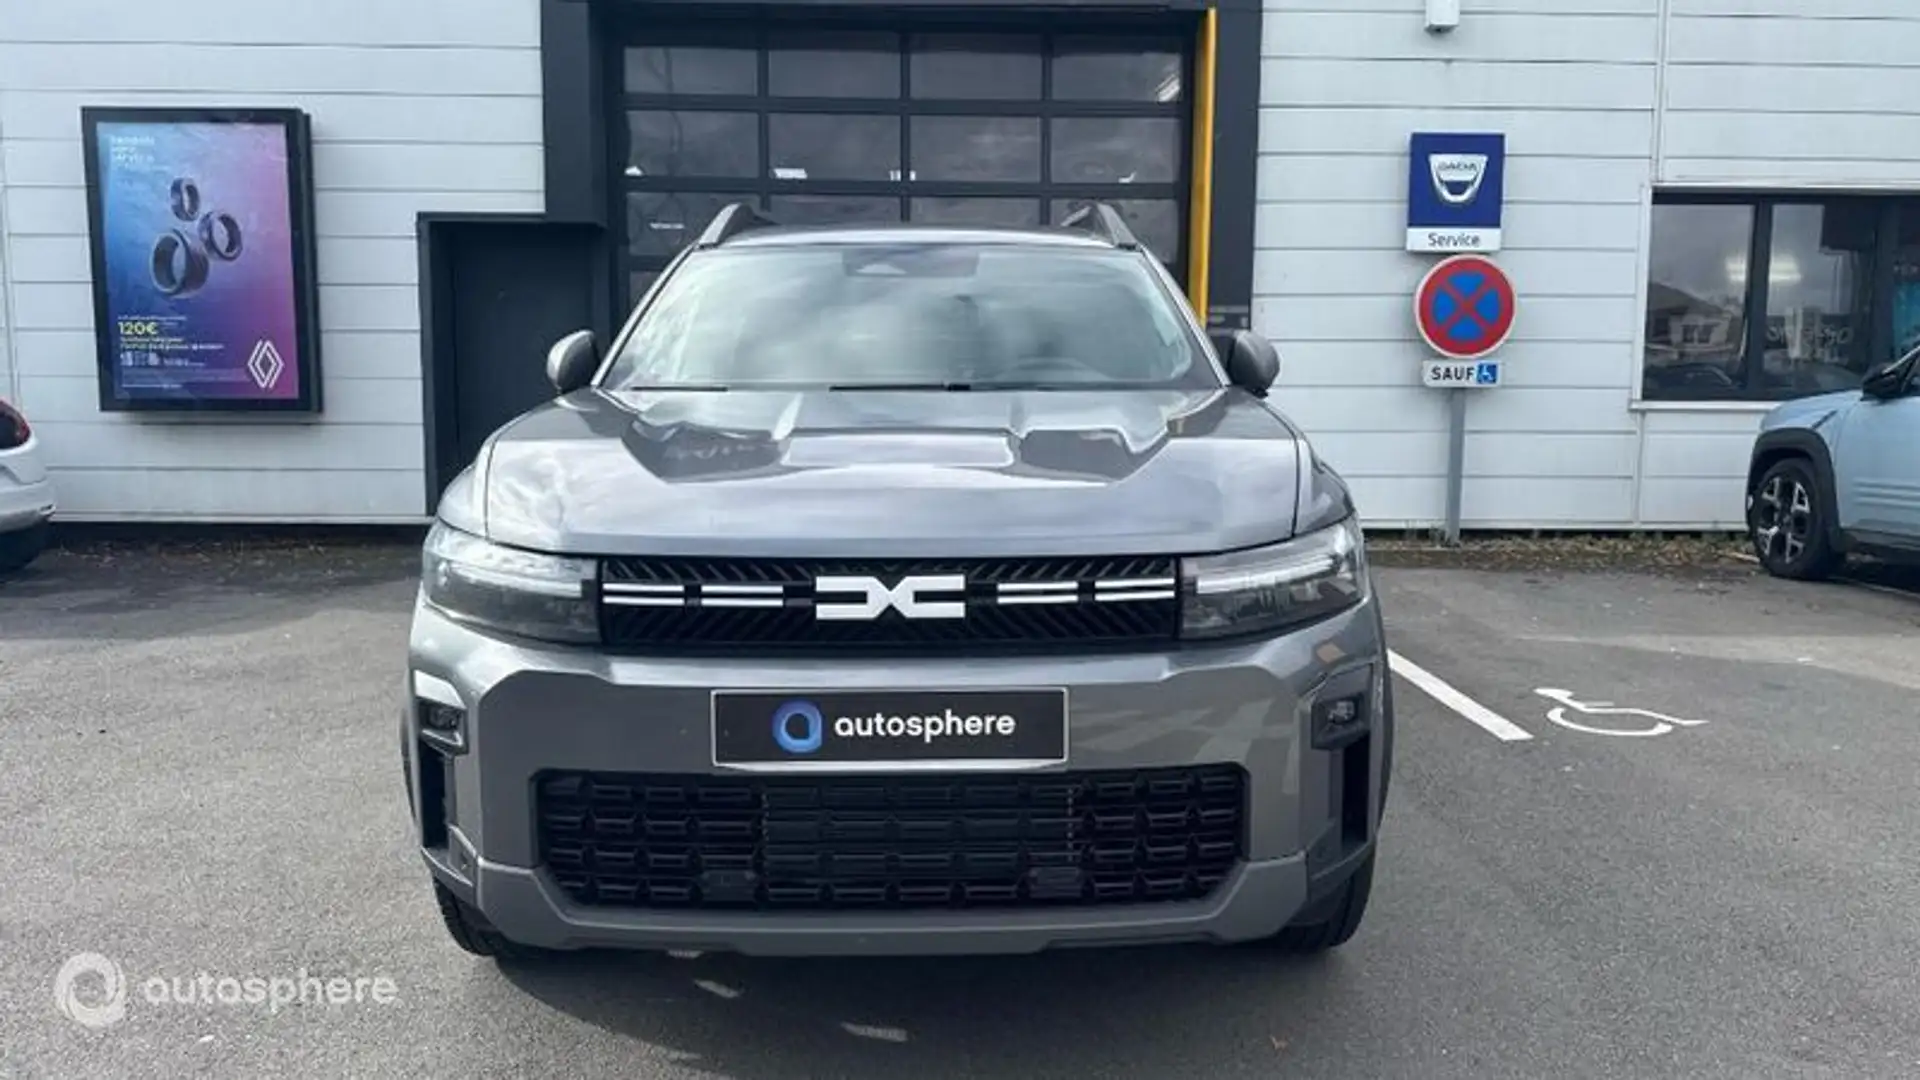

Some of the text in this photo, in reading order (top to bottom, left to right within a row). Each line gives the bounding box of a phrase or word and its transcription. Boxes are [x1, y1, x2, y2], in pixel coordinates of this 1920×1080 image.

[1428, 232, 1480, 247] Service
[118, 321, 159, 335] 120€
[1432, 366, 1475, 381] SAUF
[834, 708, 1016, 743] autosphere
